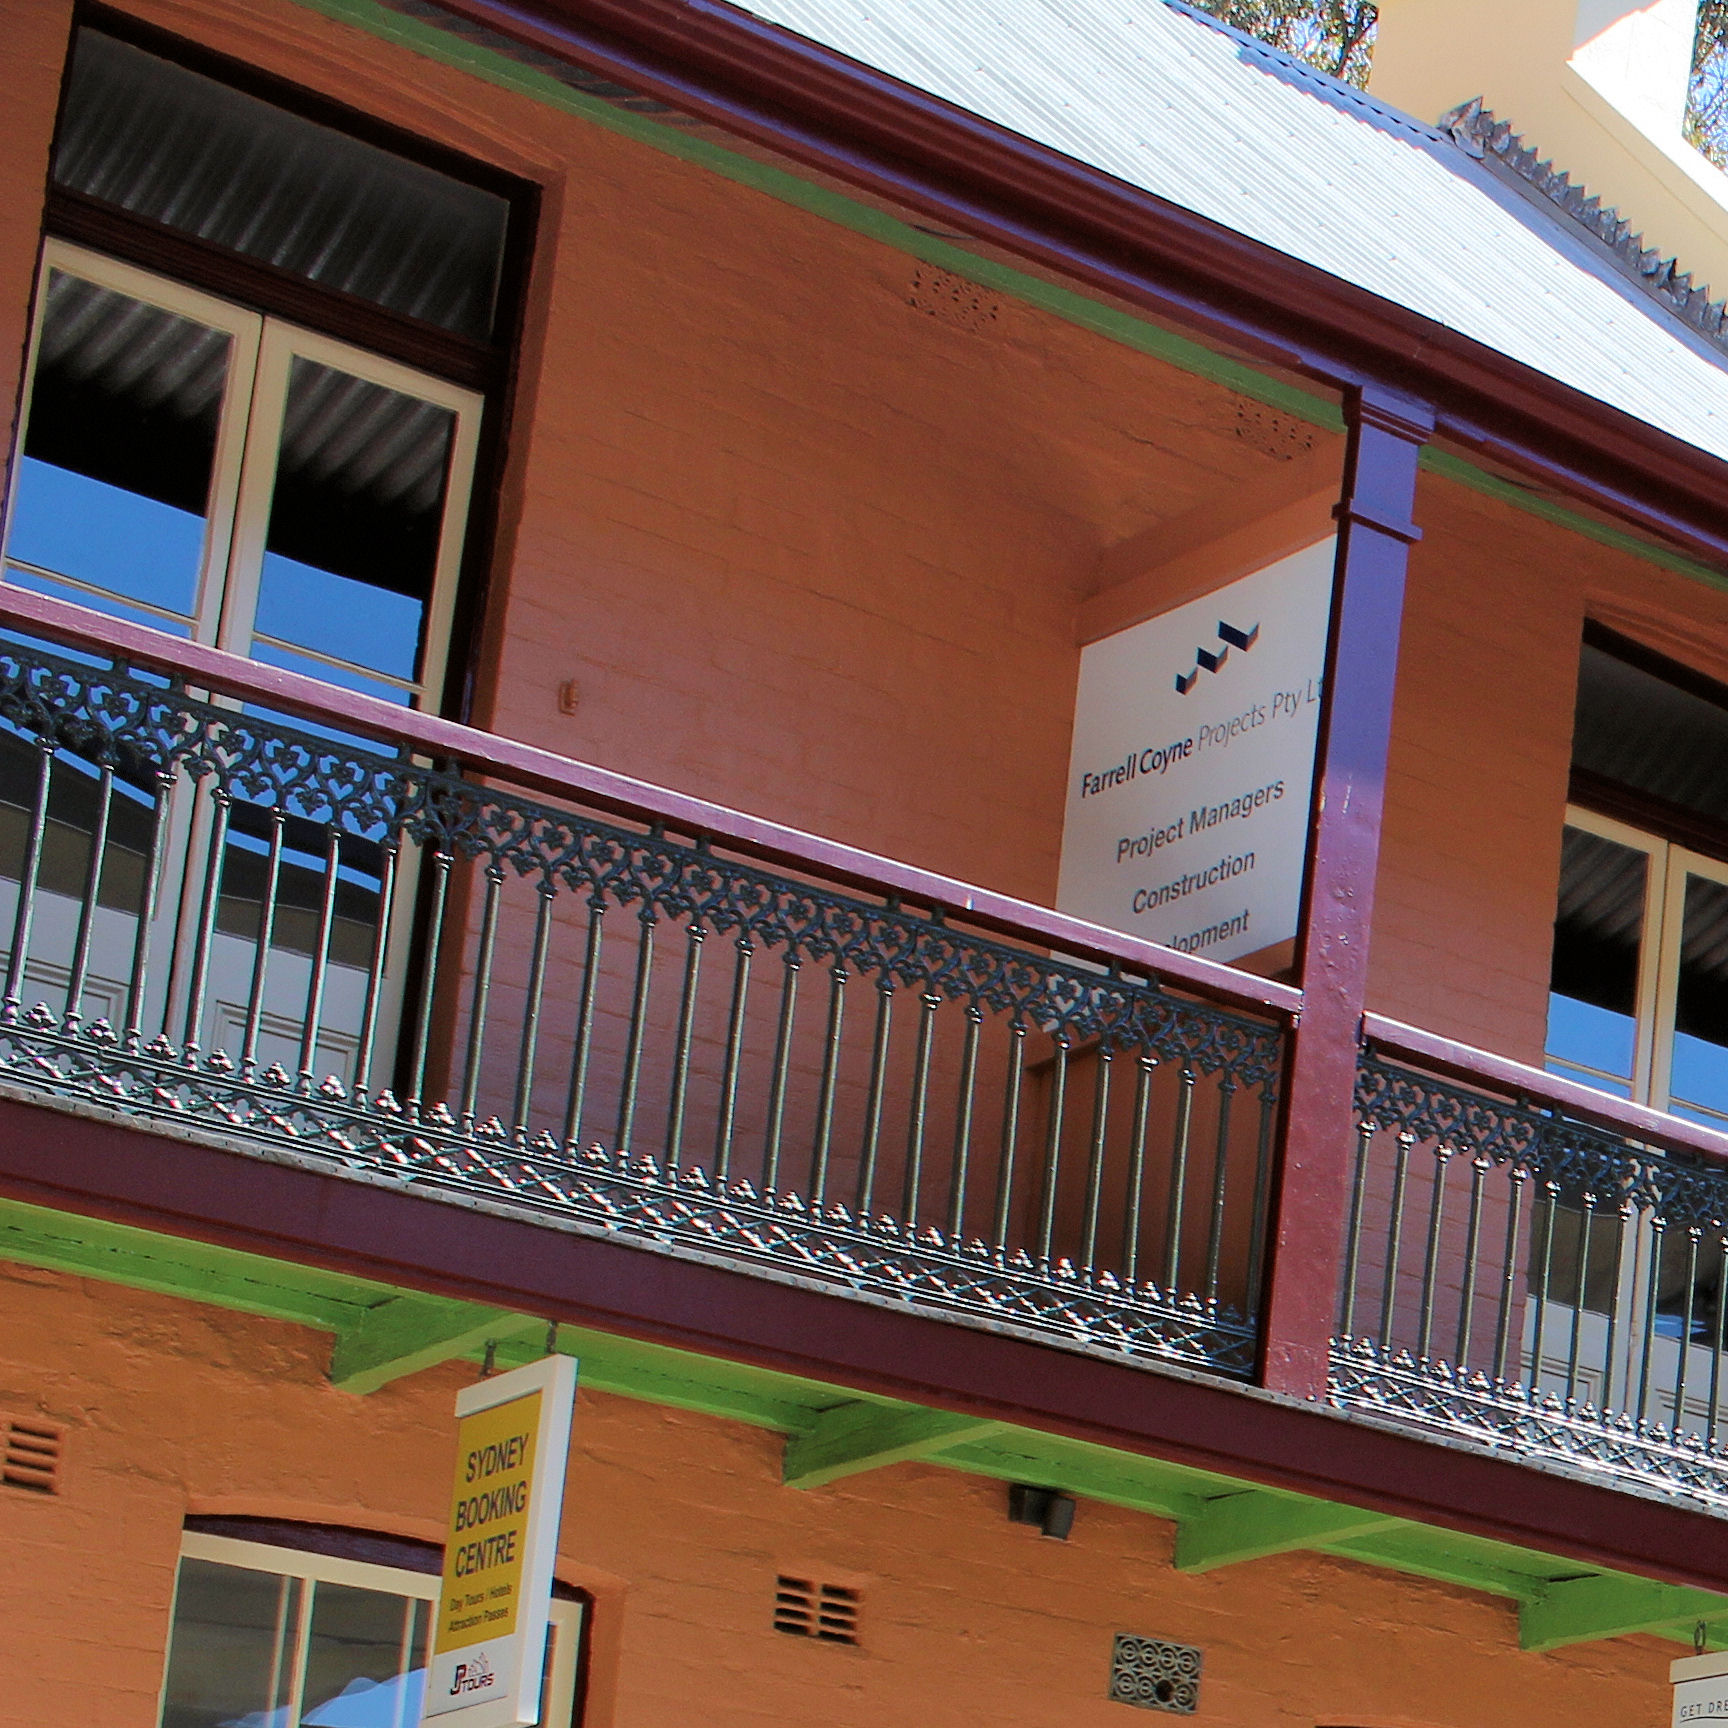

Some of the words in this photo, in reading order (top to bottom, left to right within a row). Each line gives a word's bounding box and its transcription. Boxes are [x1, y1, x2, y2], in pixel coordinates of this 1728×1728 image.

[1081, 752, 1137, 799] Farrell
[1139, 736, 1194, 780] Coyne
[1198, 702, 1267, 753] Projects
[1271, 687, 1303, 724] Pty
[1117, 821, 1183, 864] Project
[1190, 778, 1284, 832] Managers
[1132, 851, 1255, 915] Construction
[465, 1433, 530, 1483] SYDNEY
[455, 1481, 526, 1532] BOOKING
[455, 1530, 517, 1578] CENTRE
[462, 1672, 494, 1693] TOURS
[1680, 1702, 1703, 1718] GET
